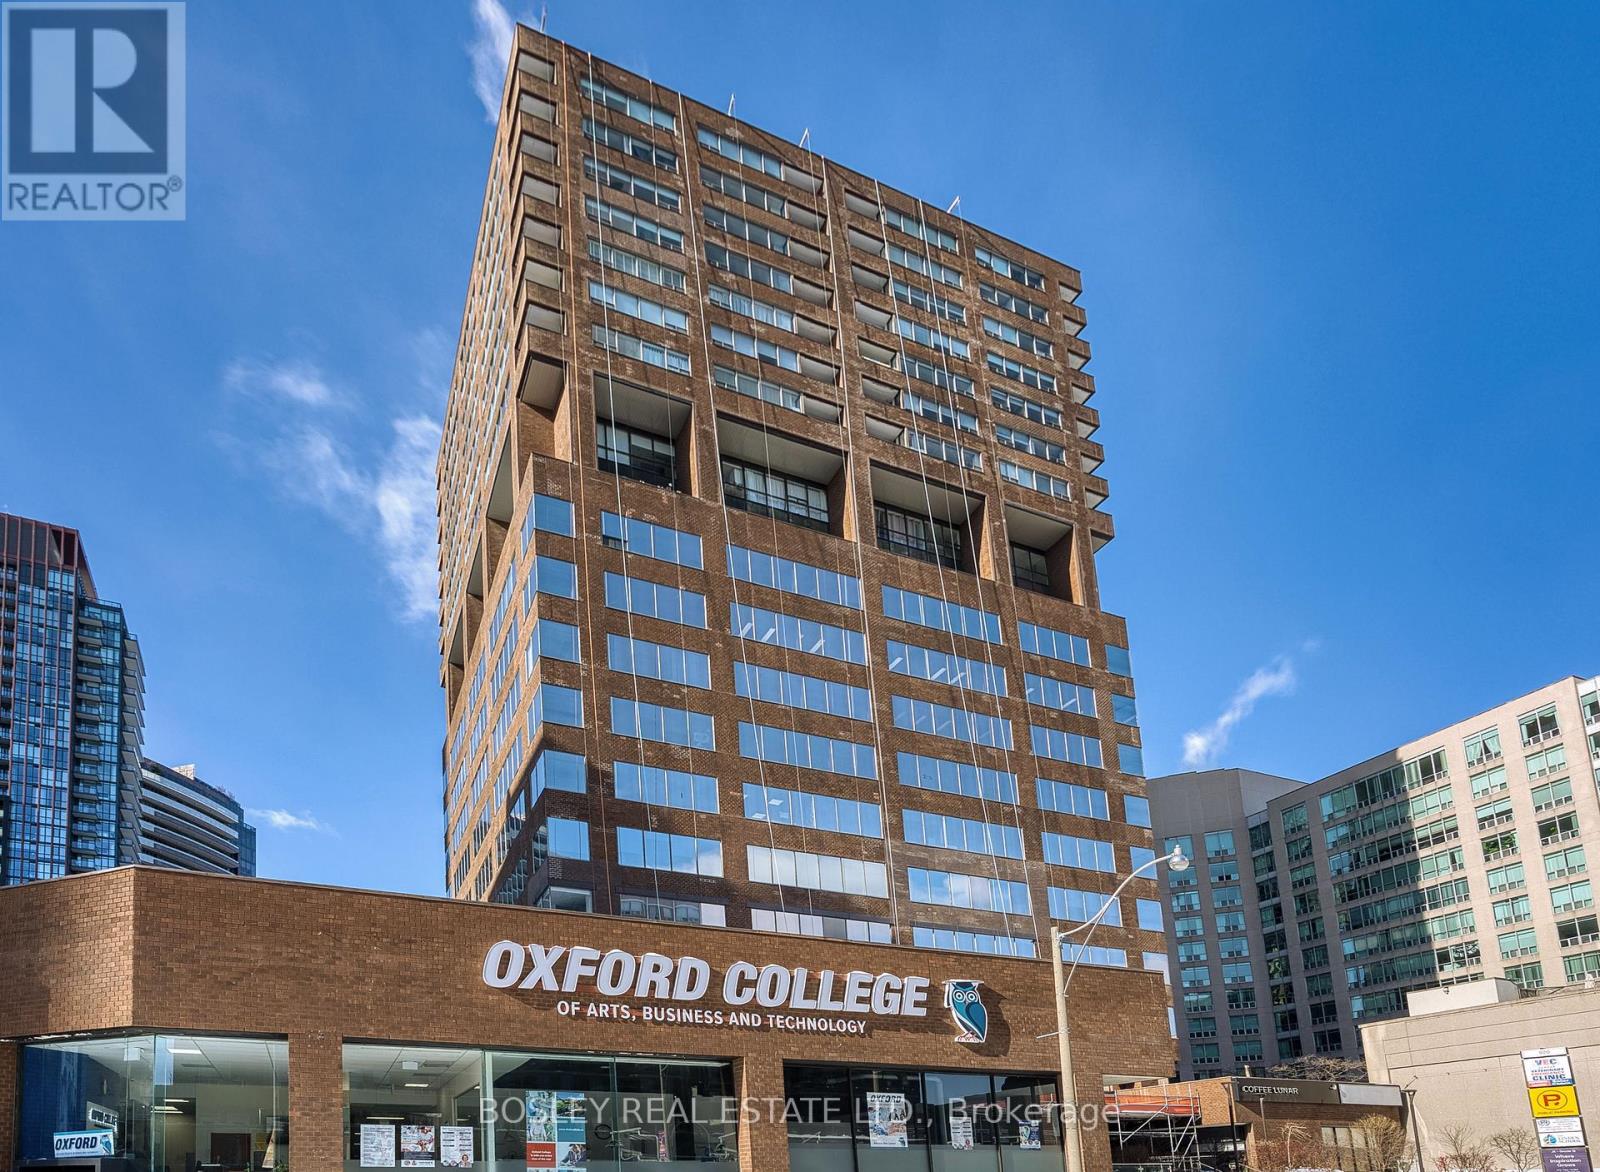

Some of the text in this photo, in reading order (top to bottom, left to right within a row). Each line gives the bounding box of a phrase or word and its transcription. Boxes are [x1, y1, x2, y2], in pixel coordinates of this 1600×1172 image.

[482, 940, 930, 1017] OXFORD COLLEGE
[556, 1000, 867, 1034] OF ARTS, BUSINESS AND TECHNOLOGY
[1241, 1085, 1299, 1095] COFFEE LUNAR
[870, 1094, 902, 1104] OXFORD
[55, 1136, 98, 1151] OXFORD
